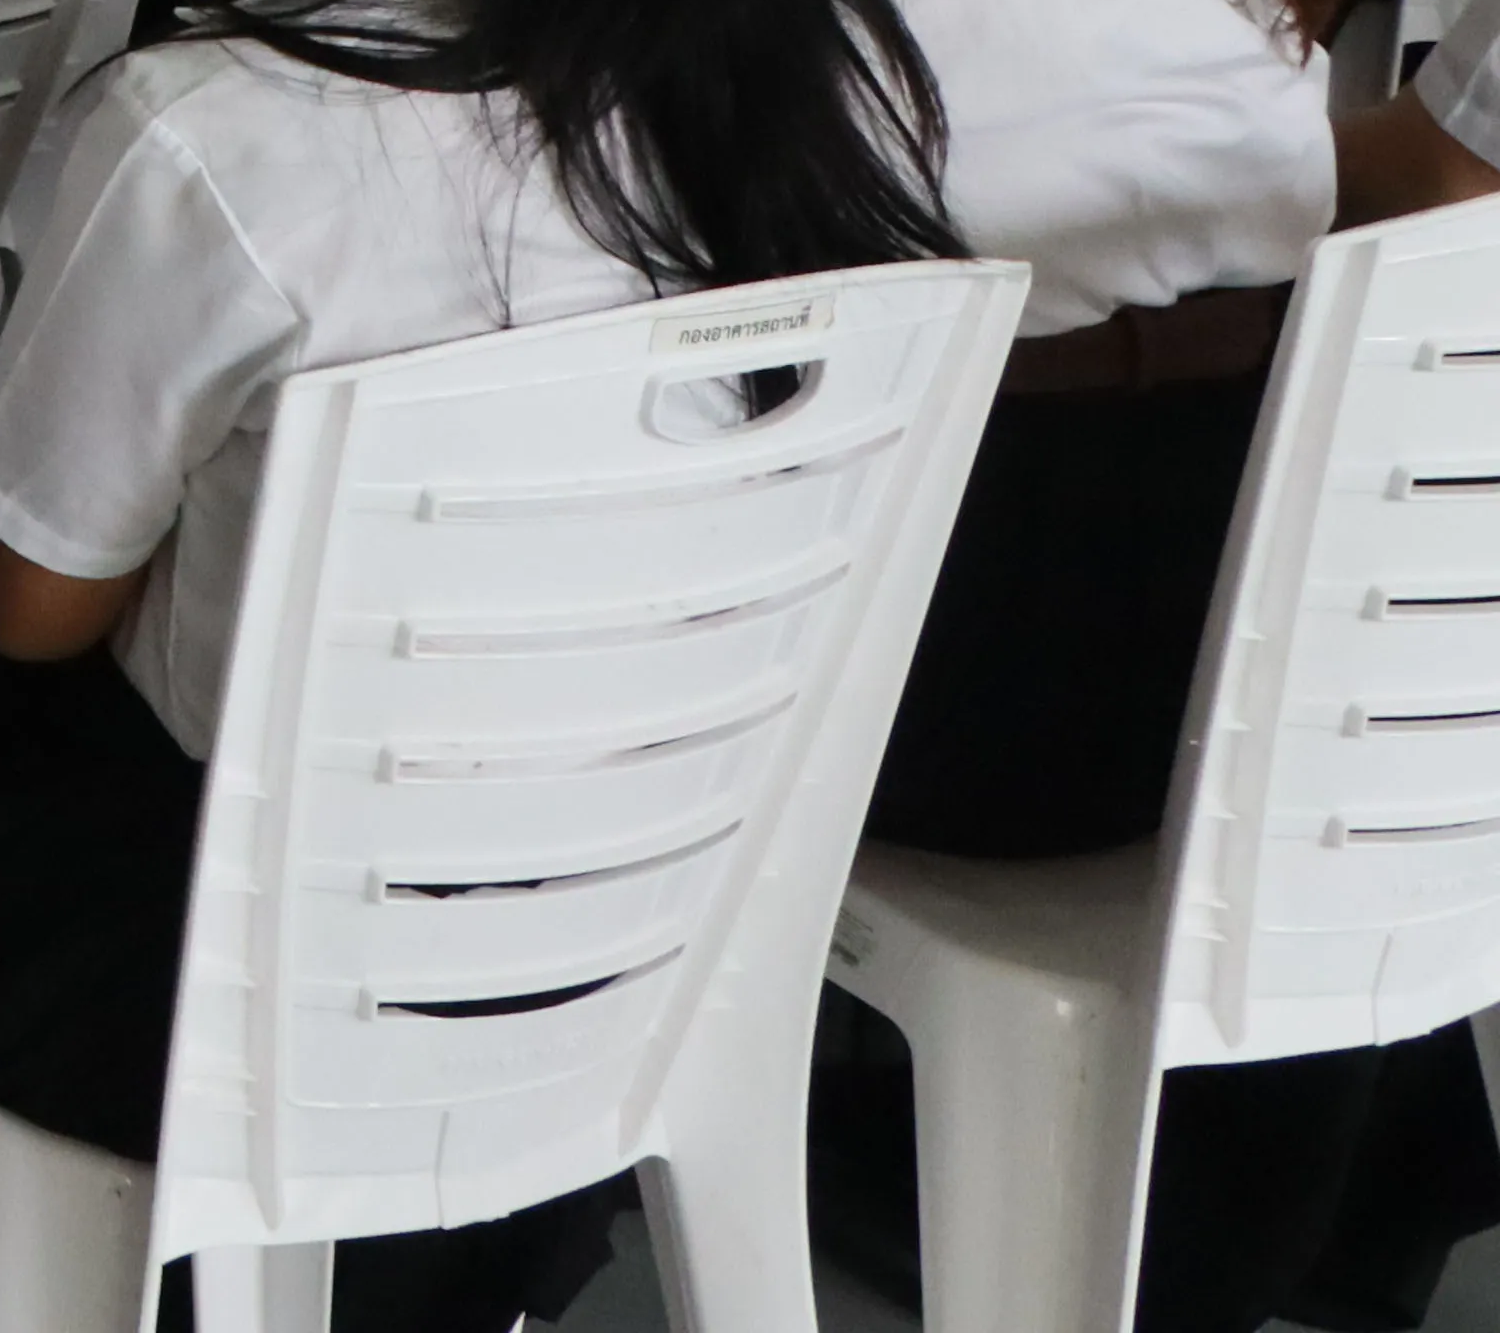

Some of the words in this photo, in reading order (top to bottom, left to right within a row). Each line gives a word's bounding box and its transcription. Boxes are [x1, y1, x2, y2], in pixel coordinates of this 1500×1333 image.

[677, 303, 812, 346] กองอาคารสถานที่
